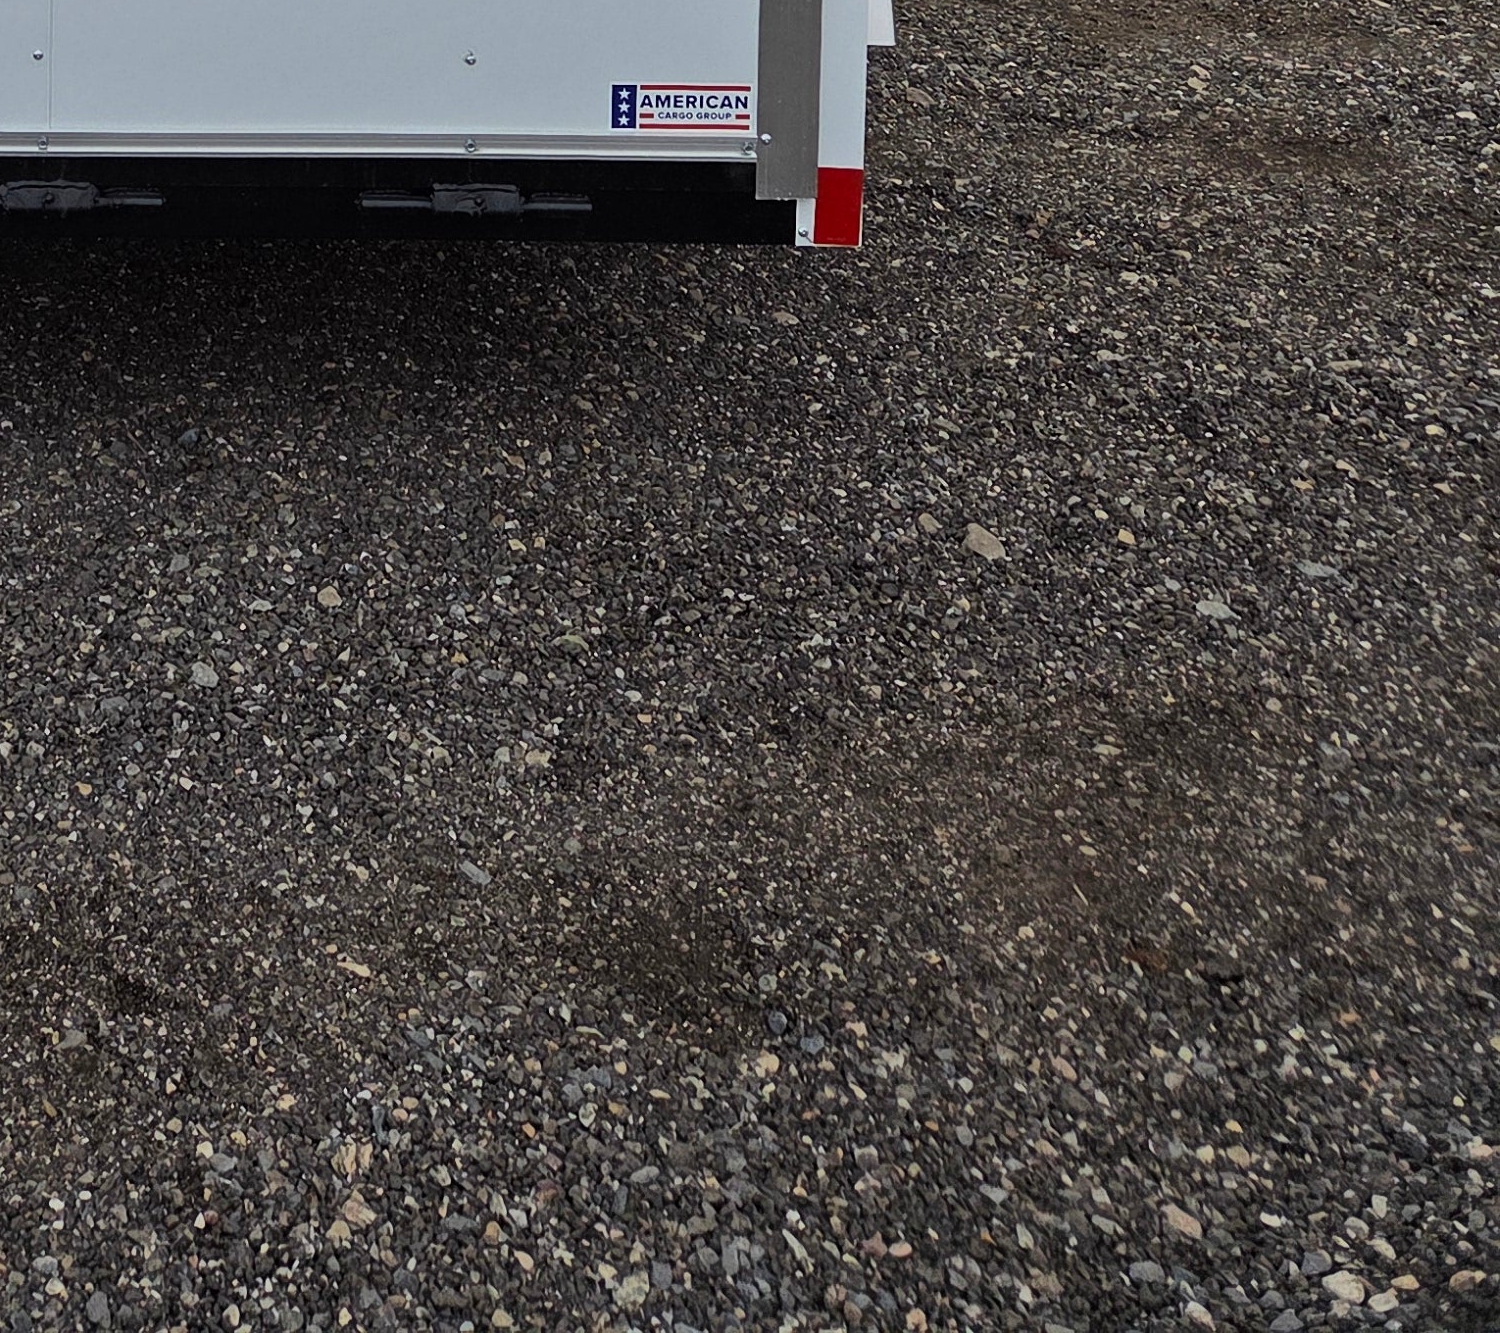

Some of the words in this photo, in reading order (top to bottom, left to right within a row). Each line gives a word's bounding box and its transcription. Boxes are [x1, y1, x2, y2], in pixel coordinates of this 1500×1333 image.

[640, 94, 748, 109] AMERICAN
[658, 111, 694, 120] CARGO
[696, 112, 732, 120] GROUP
